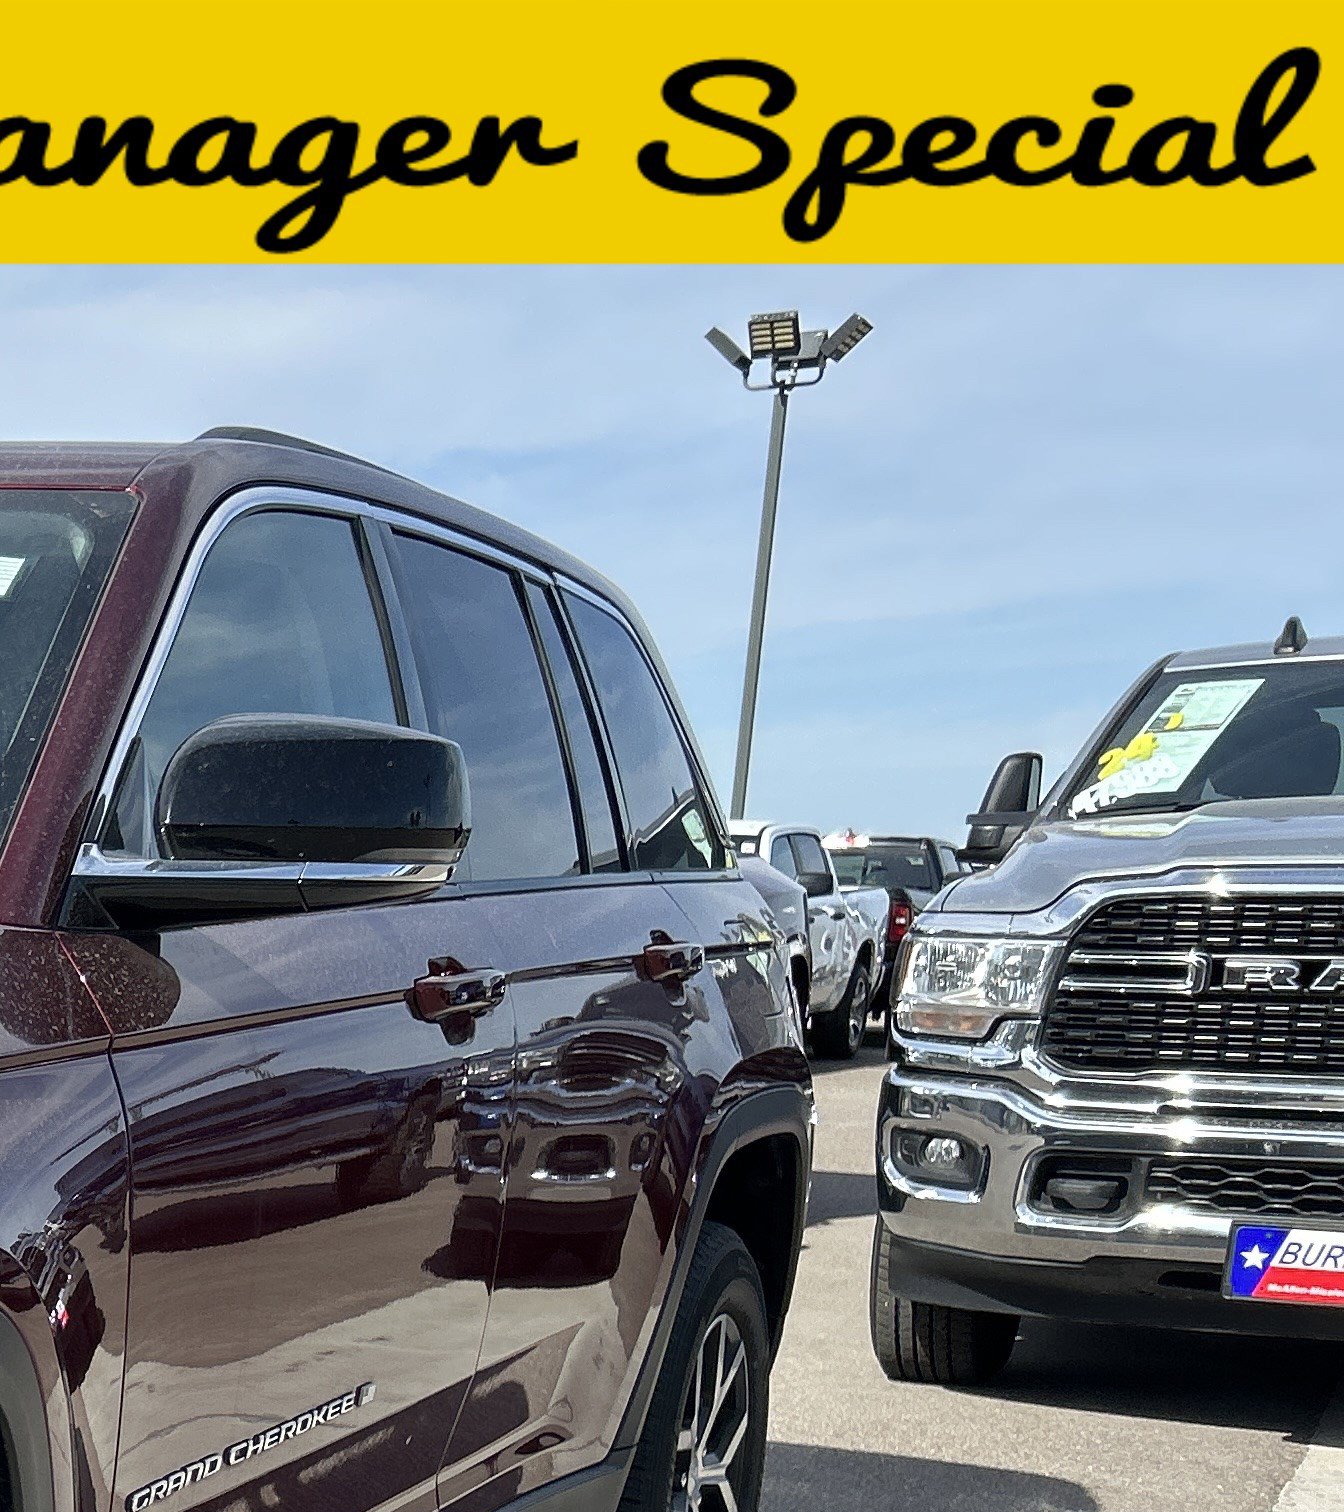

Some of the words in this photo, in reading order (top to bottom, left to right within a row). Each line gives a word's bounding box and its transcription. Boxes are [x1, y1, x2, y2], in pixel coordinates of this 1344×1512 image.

[1278, 1241, 1344, 1269] BUR
[126, 1452, 223, 1512] GRAND
[223, 1391, 356, 1466] CHEROKEE
